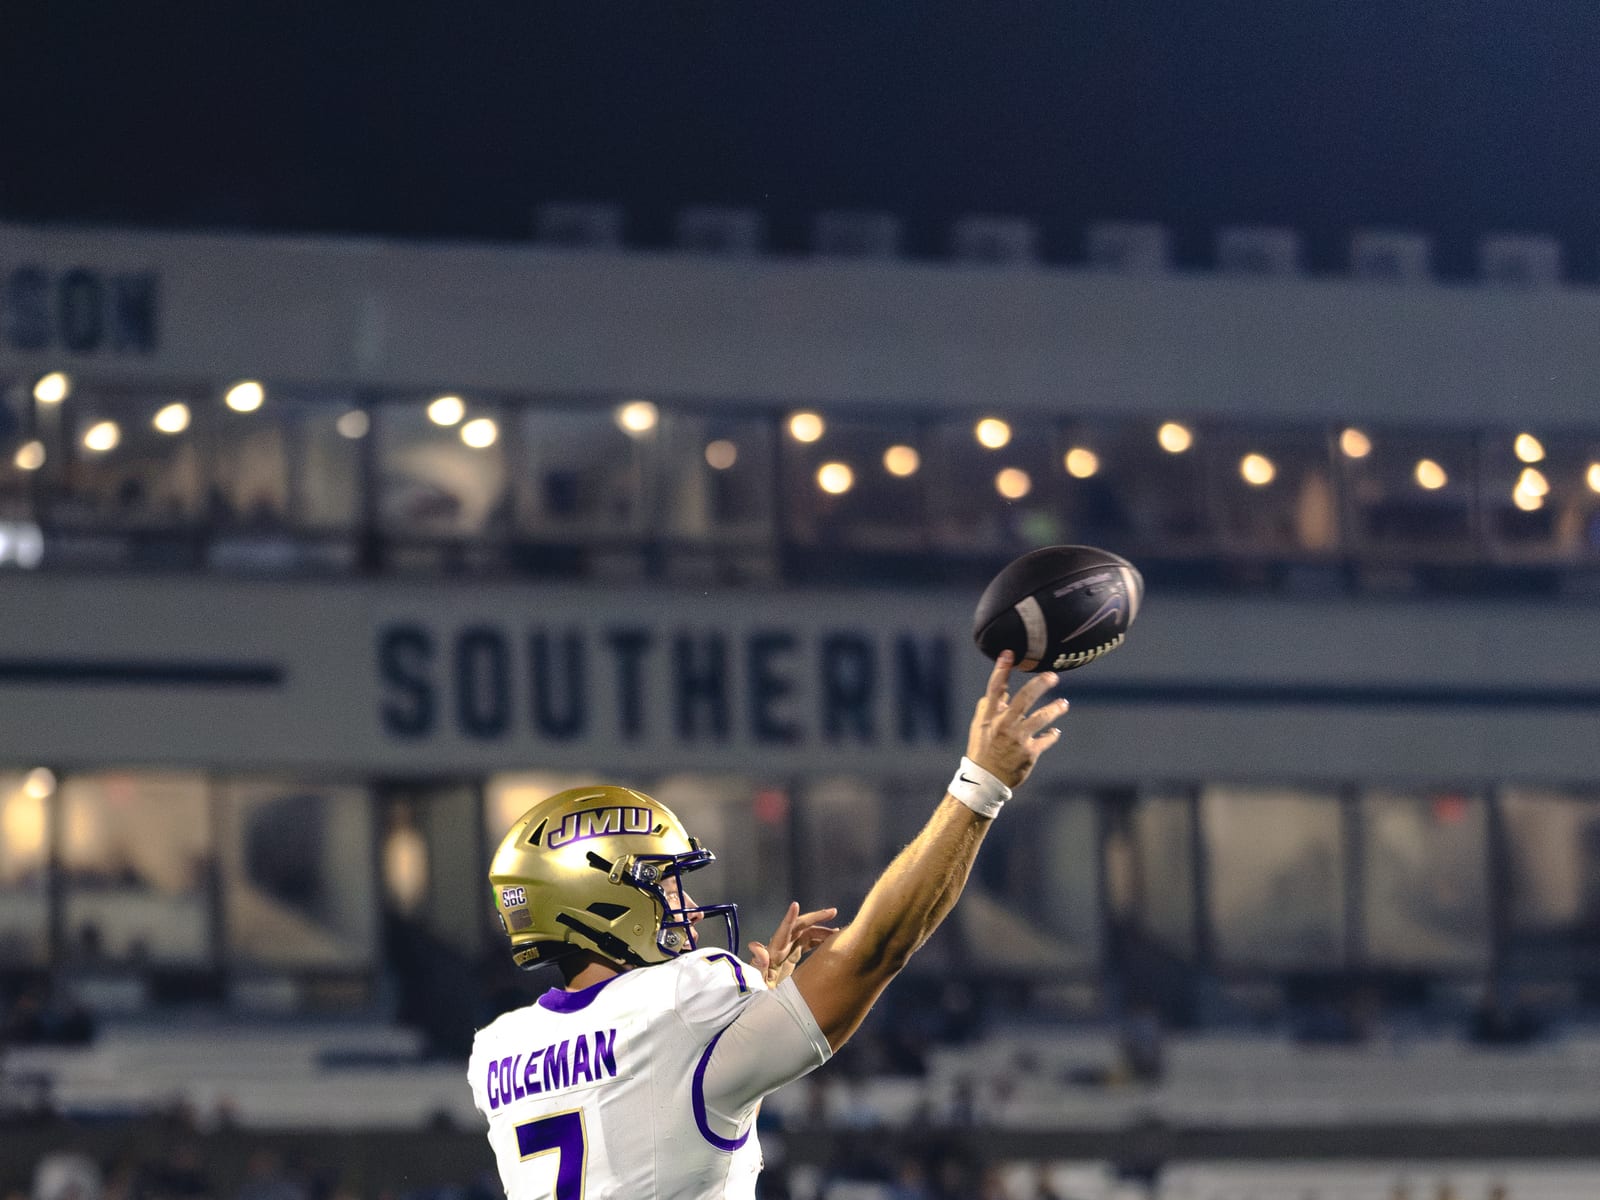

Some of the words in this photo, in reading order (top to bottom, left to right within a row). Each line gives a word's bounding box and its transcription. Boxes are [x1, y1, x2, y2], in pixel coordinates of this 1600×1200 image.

[378, 622, 956, 743] SOUTHERN
[548, 806, 653, 850] JMU
[702, 952, 752, 997] 7
[487, 1028, 617, 1110] COLEMAN
